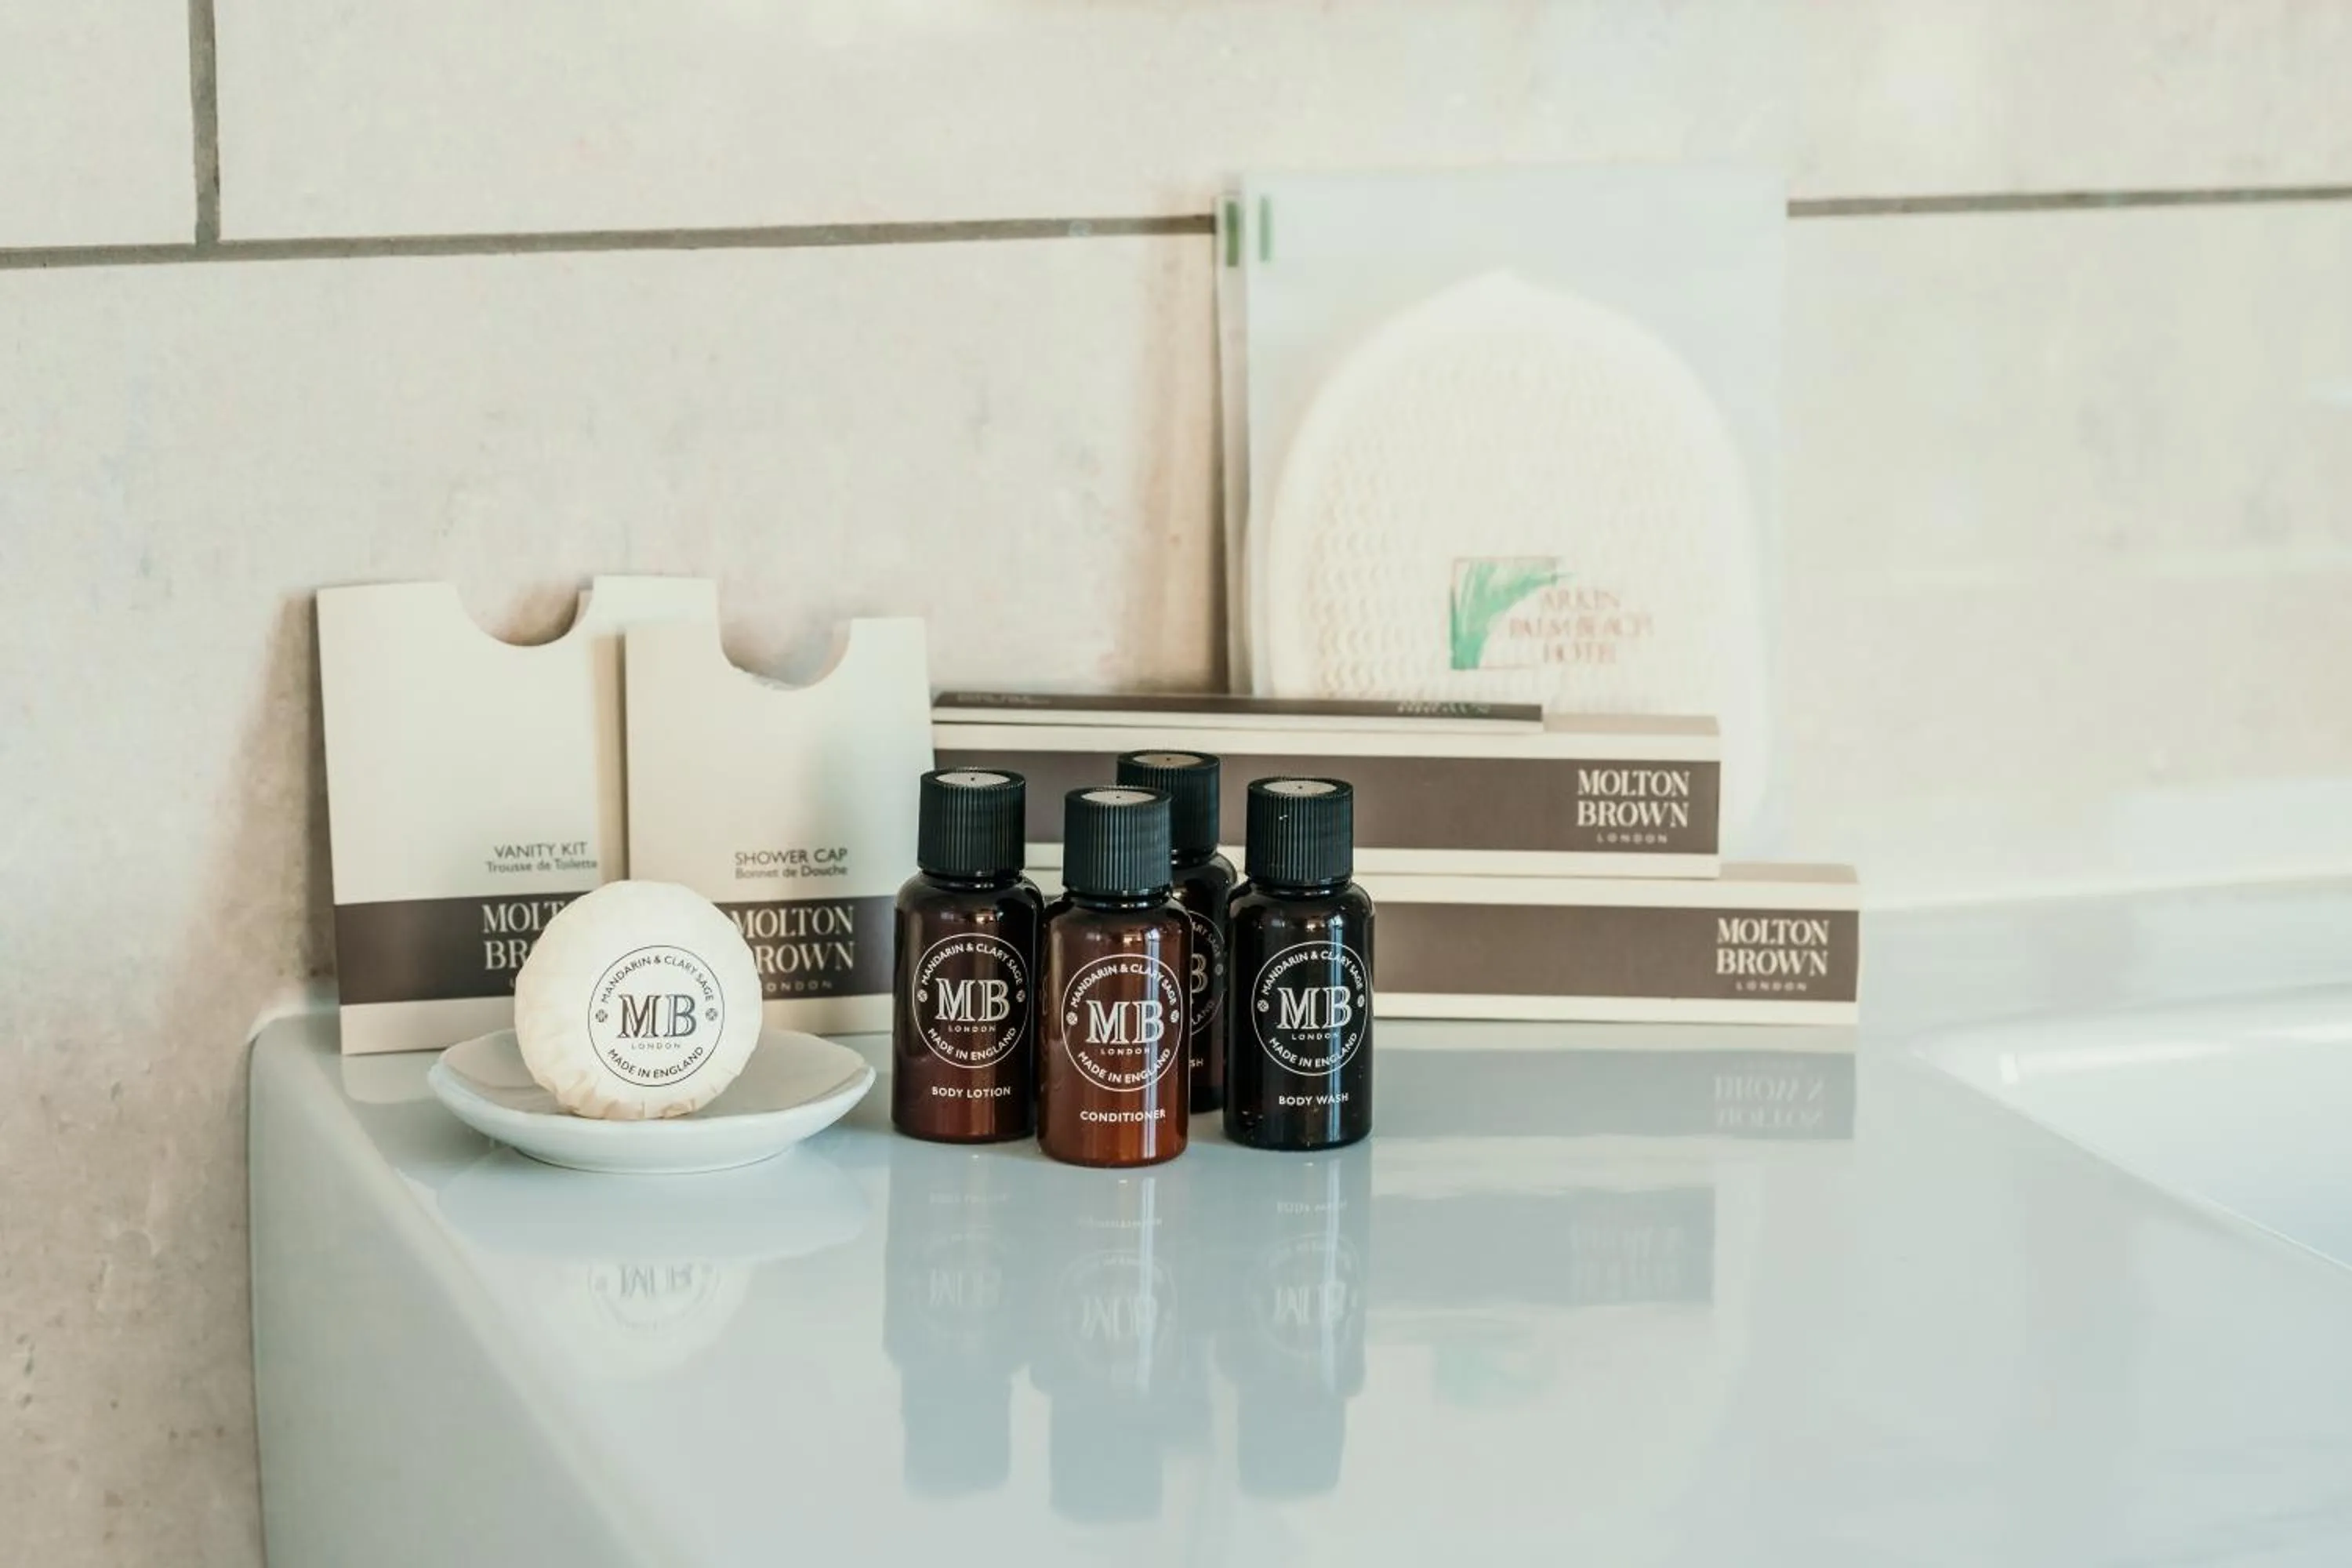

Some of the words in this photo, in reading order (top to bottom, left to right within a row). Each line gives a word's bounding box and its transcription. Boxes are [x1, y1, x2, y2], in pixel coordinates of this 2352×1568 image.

[1577, 769, 1690, 797] MOLTON
[1577, 800, 1690, 828] BROWN
[494, 843, 556, 858] VANITY
[561, 841, 587, 855] KIT
[1596, 832, 1668, 844] LONDON
[485, 862, 533, 873] Trousse
[537, 860, 551, 871] de
[555, 858, 597, 870] Toilette
[735, 850, 808, 866] SHOWER
[814, 848, 848, 862] CAP
[735, 867, 779, 879] Bonnet
[782, 867, 797, 878] de
[800, 866, 848, 878] Douche
[481, 902, 565, 933] MOLT
[731, 906, 855, 938] MOLTON
[1716, 917, 1830, 946] MOLTON
[754, 942, 855, 974] ROWN
[922, 944, 964, 985] MANDARIN
[966, 942, 974, 952] &
[976, 943, 1007, 962] CLARY
[1007, 959, 1023, 985] SAGE
[1261, 952, 1308, 995] MANDARIN
[1310, 950, 1318, 960] &
[1320, 950, 1352, 968] CLARY
[1349, 964, 1363, 991] SAGE
[1715, 948, 1828, 977] BROWN
[601, 956, 652, 1004] MANDARIN
[654, 955, 661, 964] &
[664, 955, 698, 975] CLARY
[695, 973, 713, 1001] SAGE
[766, 981, 833, 993] ONDON
[1070, 964, 1117, 1008] MANDARIN
[1120, 964, 1128, 973] &
[1130, 963, 1164, 982] CLARY
[1161, 979, 1177, 1005] SAGE
[1735, 981, 1807, 992] LONDON
[935, 978, 1011, 1022] MB
[1192, 1000, 1214, 1025] LAND
[1276, 985, 1352, 1030] MB
[616, 994, 697, 1039] MB
[1085, 1000, 1165, 1044] MB
[927, 1028, 954, 1054] MADE
[956, 1049, 968, 1060] IN
[970, 1027, 1016, 1061] ENGLAND
[1100, 1047, 1150, 1056] LONDON
[1269, 1037, 1298, 1063] MADE
[1298, 1058, 1312, 1068] IN
[1315, 1033, 1357, 1068] ENGLAND
[608, 1048, 635, 1074] MADE
[638, 1068, 650, 1078] IN
[653, 1047, 703, 1079] ENGLAND
[1077, 1051, 1107, 1078] MADE
[1108, 1073, 1122, 1083] IN
[1124, 1048, 1171, 1083] ENGLAND
[931, 1087, 963, 1097] BODY
[967, 1086, 1011, 1098] LOTION
[1279, 1095, 1312, 1105] BODY
[1316, 1093, 1349, 1105] WASH
[1080, 1109, 1166, 1122] CONDITIONER
